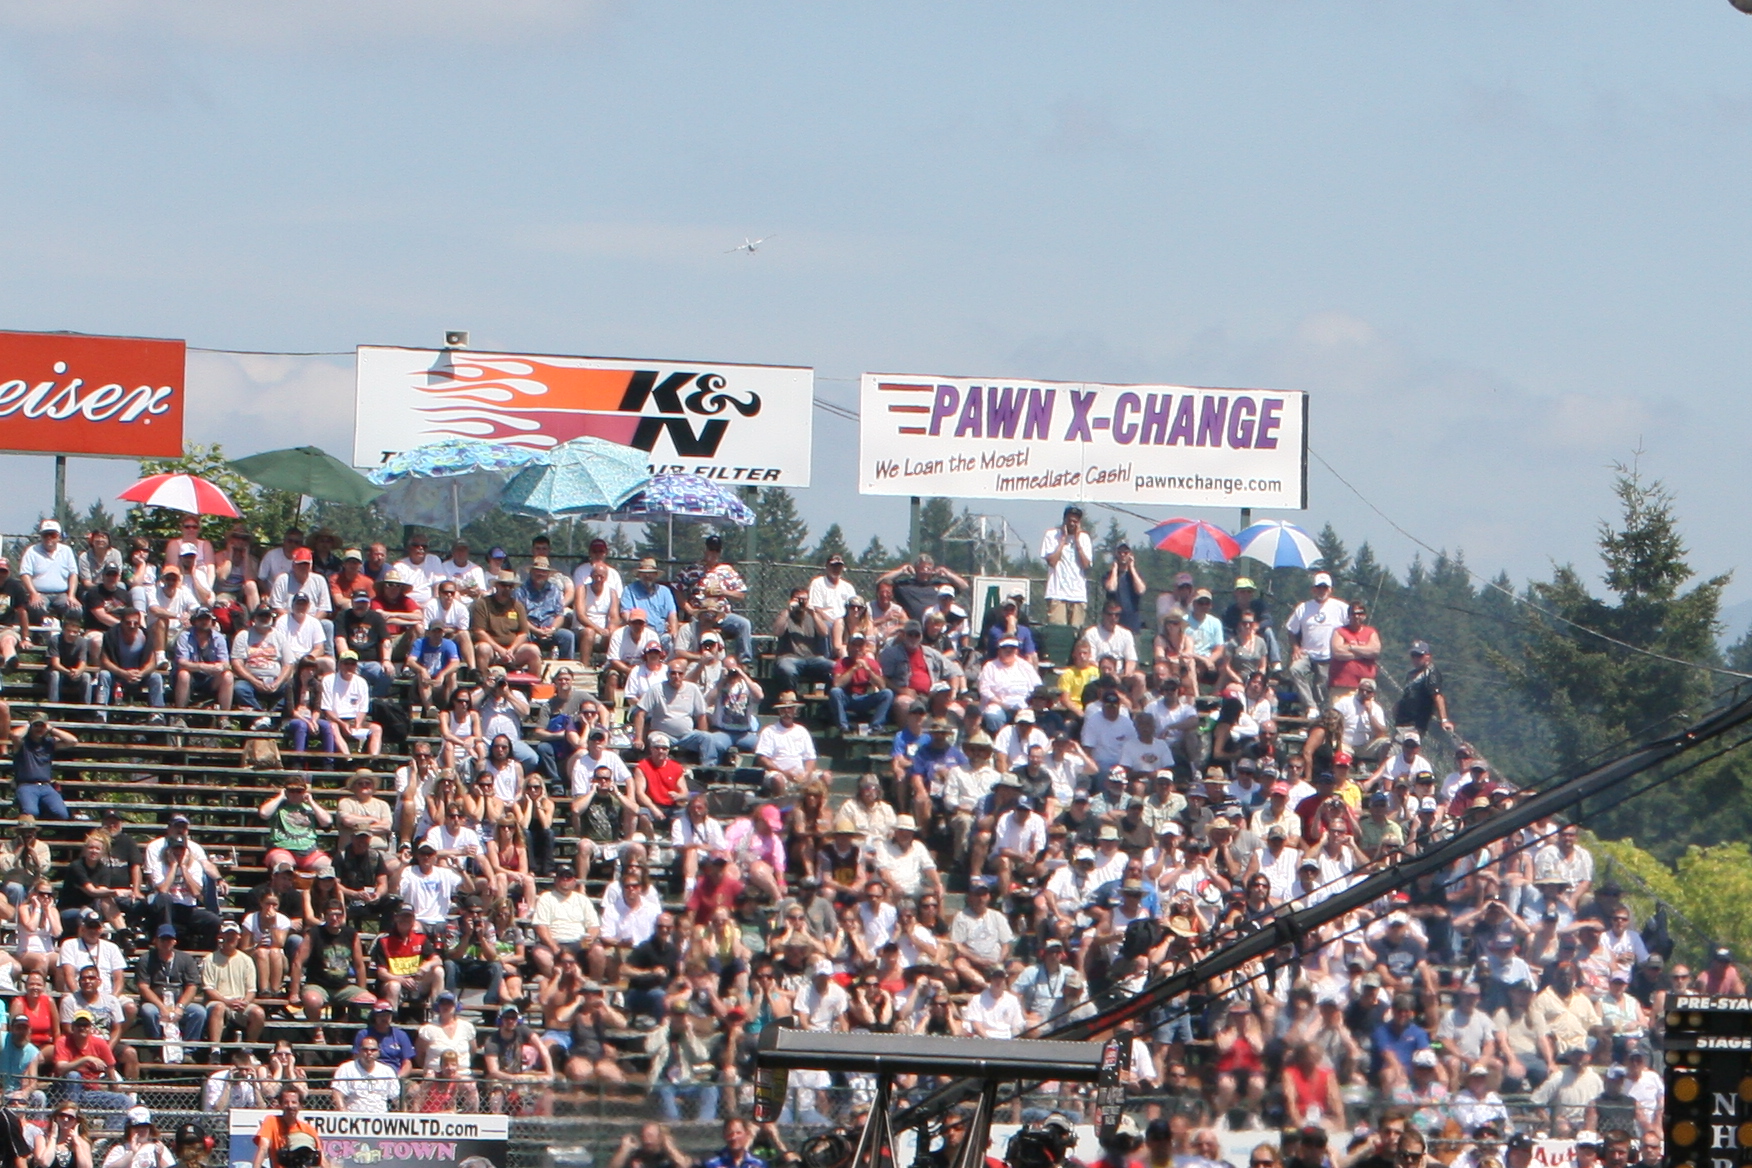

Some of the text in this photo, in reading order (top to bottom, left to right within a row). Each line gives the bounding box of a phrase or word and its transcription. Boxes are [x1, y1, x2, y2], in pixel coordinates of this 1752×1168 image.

[928, 384, 1284, 450] PAWN X-CHANGE
[694, 465, 782, 482] FILTER
[876, 459, 899, 479] We
[904, 457, 943, 476] Loan
[949, 452, 976, 472] the
[995, 469, 1081, 492] Immediate
[1135, 473, 1282, 494] pawnxchange.com
[1696, 1038, 1752, 1049] STAGE
[303, 1116, 479, 1138] TRUCKTOWNLTD.com
[379, 1141, 457, 1161] TOWN
